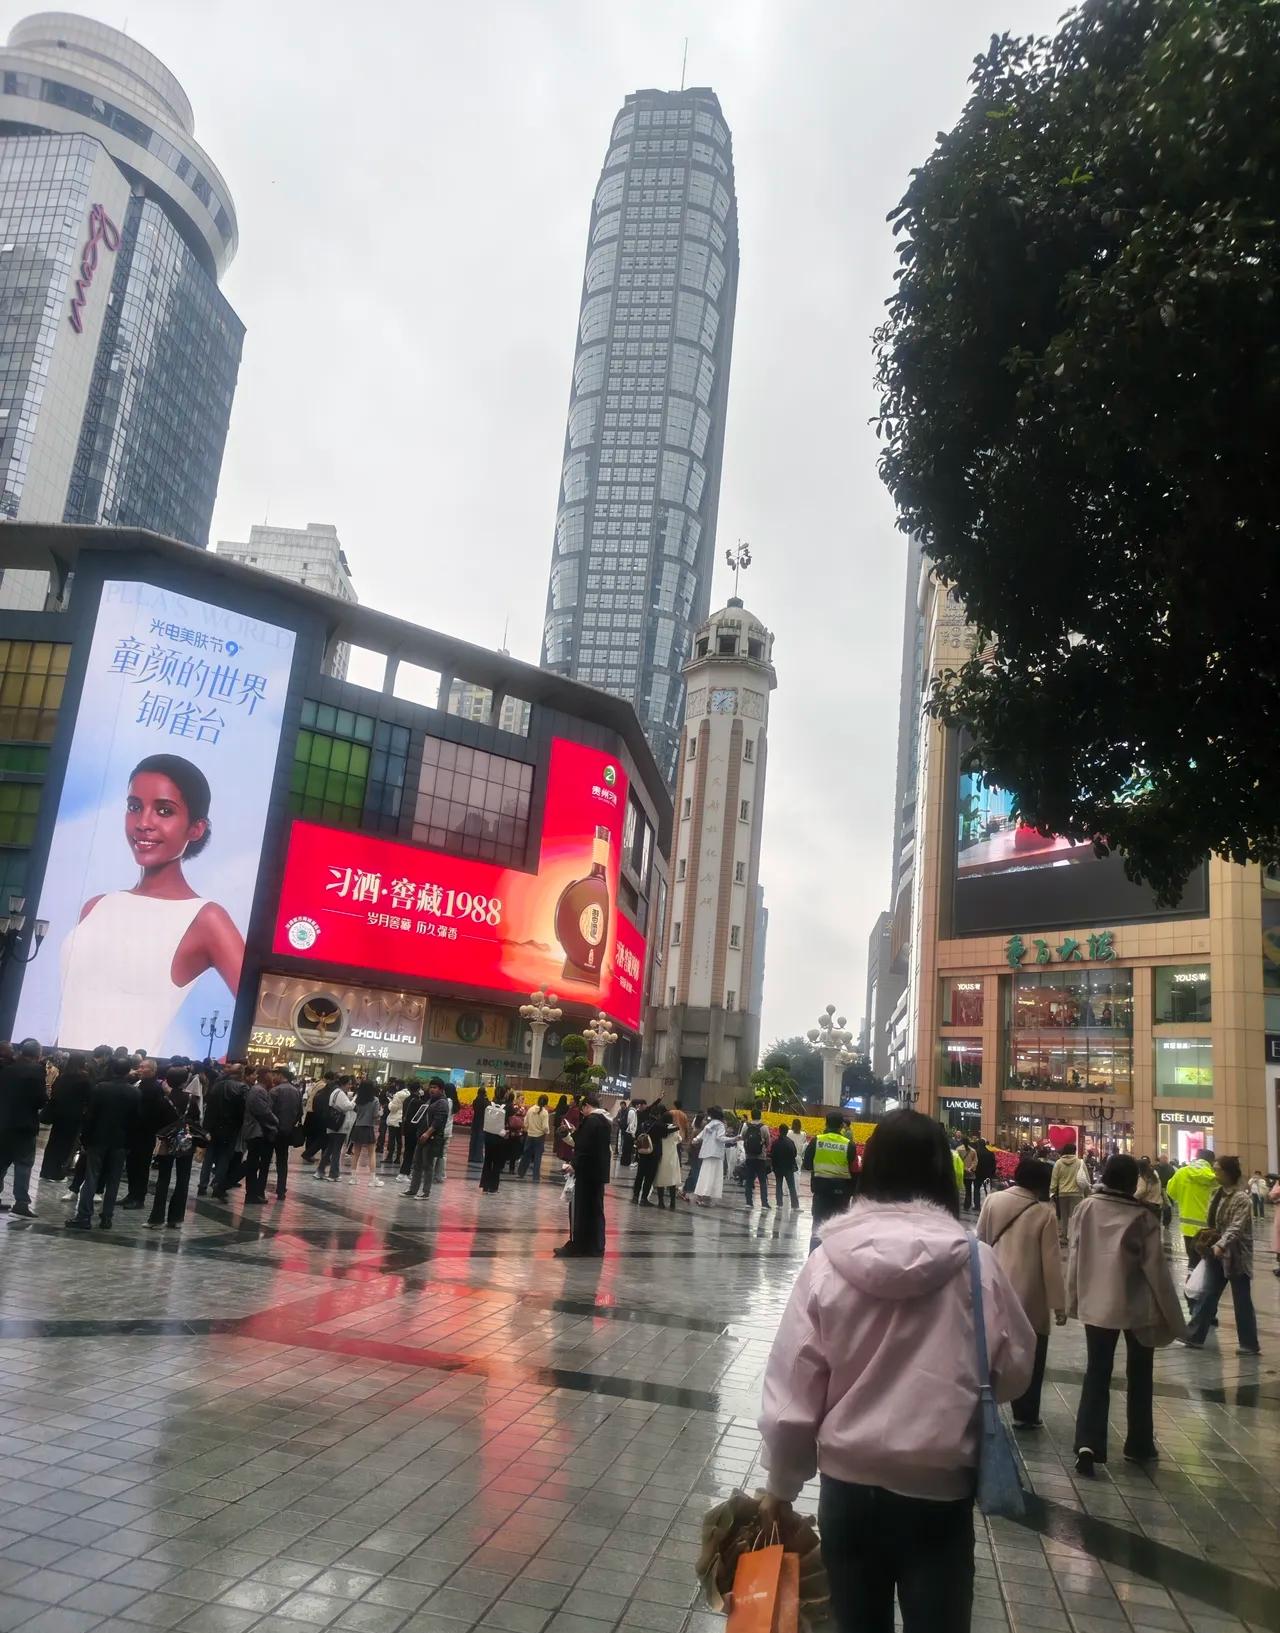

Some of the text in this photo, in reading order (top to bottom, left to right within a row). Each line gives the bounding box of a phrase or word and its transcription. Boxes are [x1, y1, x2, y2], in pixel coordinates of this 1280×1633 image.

[150, 618, 223, 653] 光电美肤节
[107, 636, 267, 715] 童颜的世界
[135, 691, 225, 744] 铜雀台
[325, 865, 502, 926] 习酒·窖藏1988
[367, 912, 412, 932] 岁月窖藏
[252, 1031, 297, 1049] 巧克力馆
[350, 1028, 416, 1044] ZHOU LIU FU
[354, 1043, 389, 1059] 周六福
[1186, 1114, 1215, 1124] LAUDE
